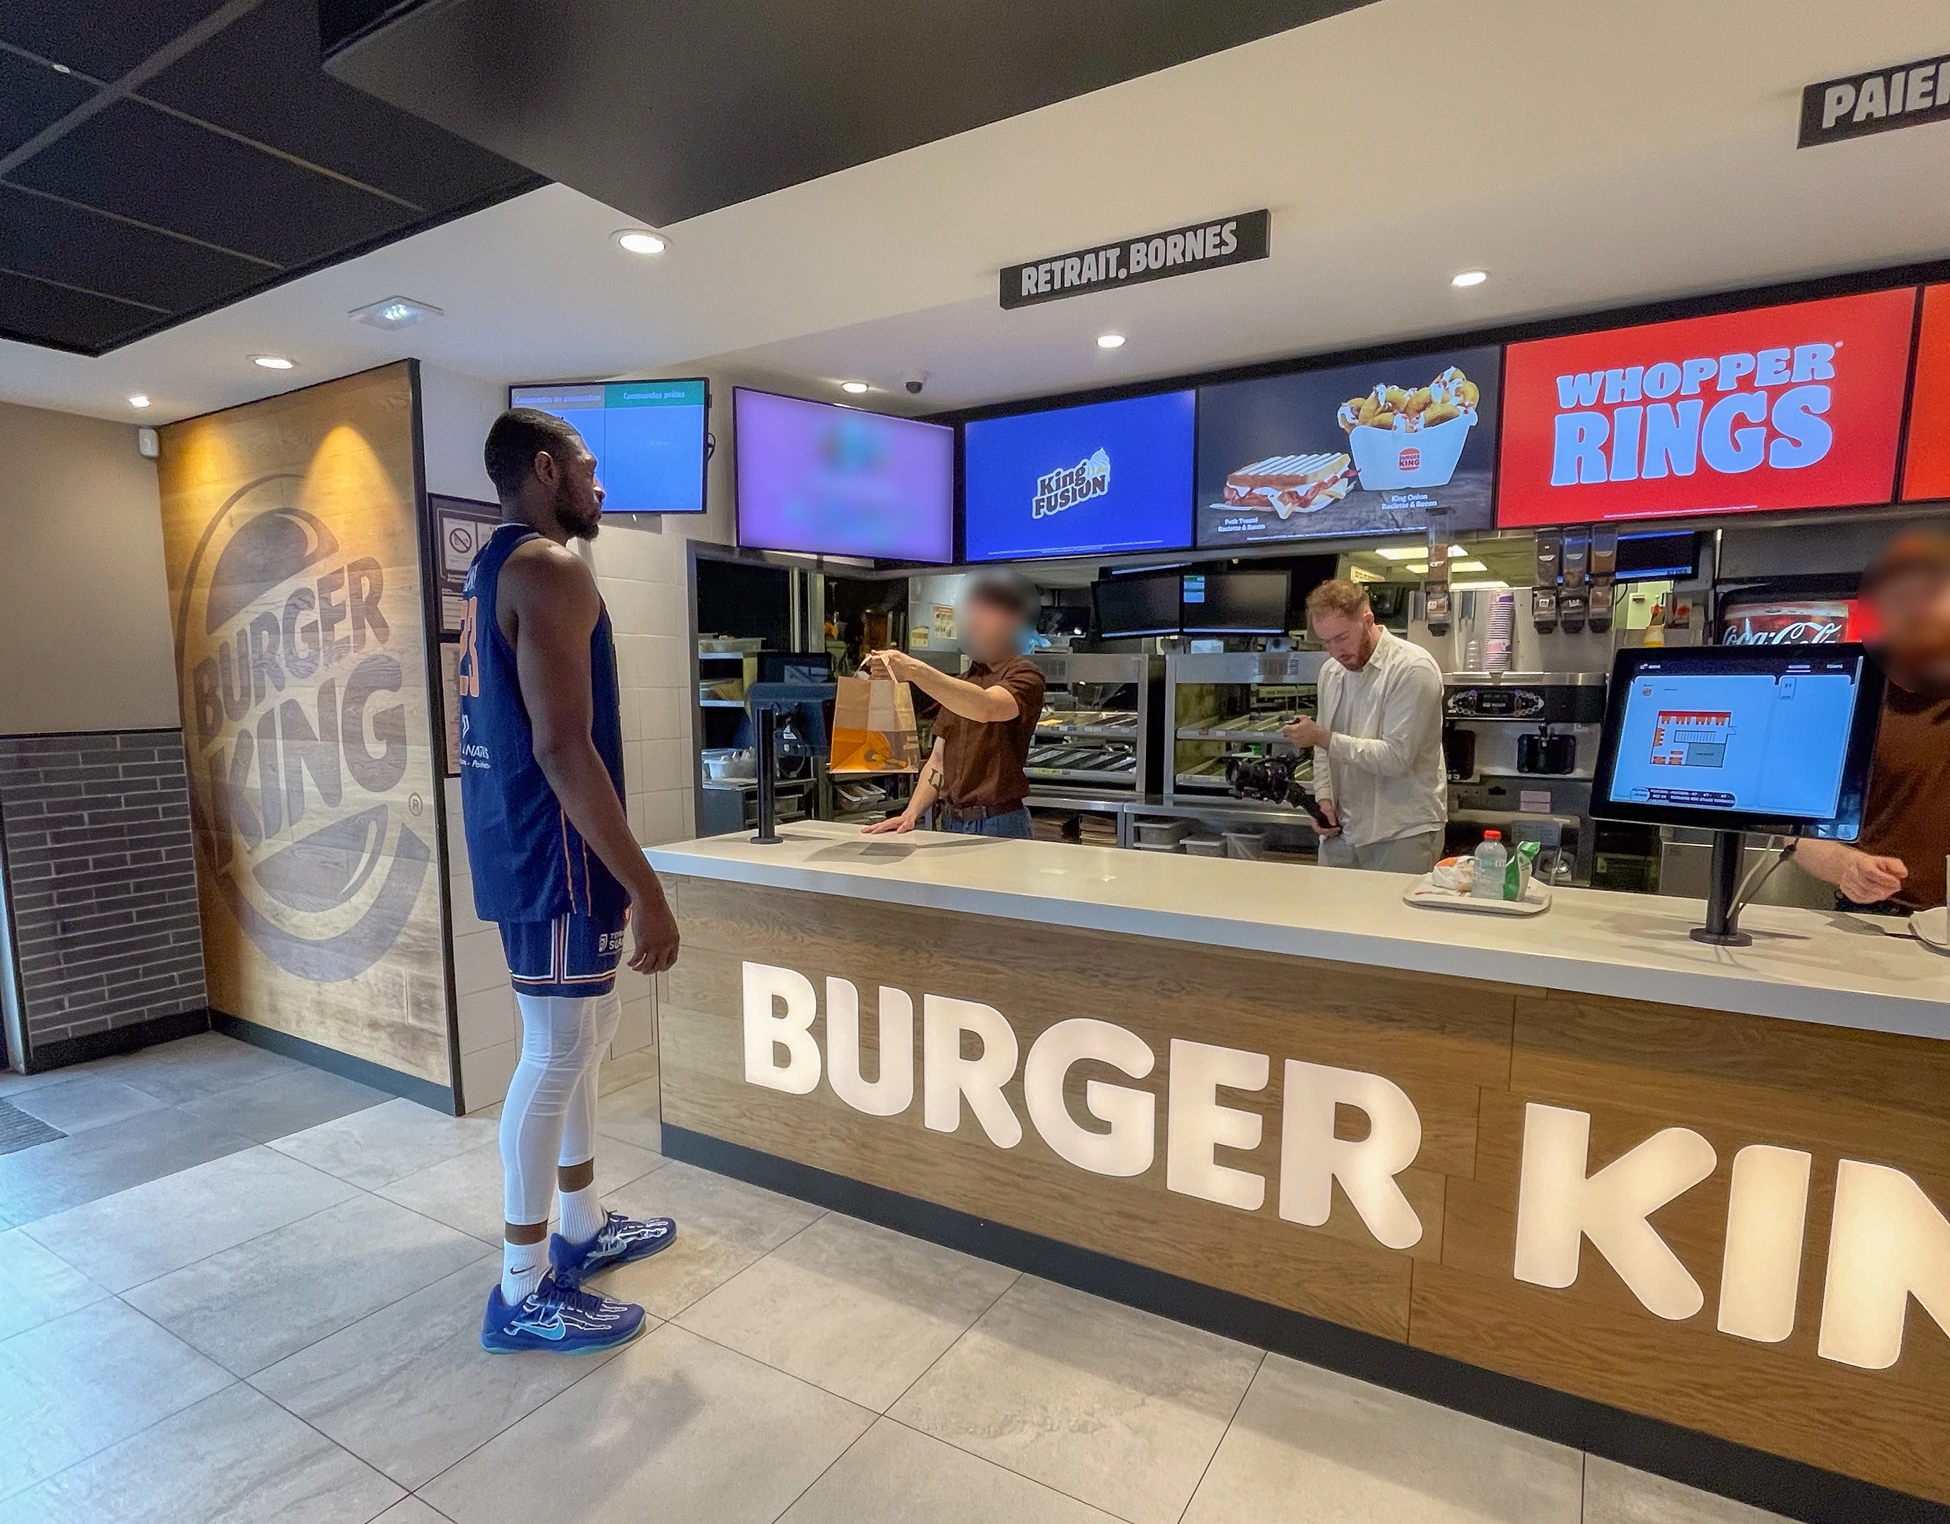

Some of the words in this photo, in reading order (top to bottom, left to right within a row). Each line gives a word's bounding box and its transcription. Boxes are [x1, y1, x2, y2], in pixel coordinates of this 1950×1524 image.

[1556, 342, 1836, 409] WHOPPER
[1399, 459, 1420, 467] KING
[1550, 385, 1834, 487] RINGS
[1034, 474, 1107, 517] FUSION
[1040, 461, 1088, 497] King
[194, 556, 390, 744] BURGER
[208, 653, 408, 874] KING
[742, 961, 1423, 1251] BURGER
